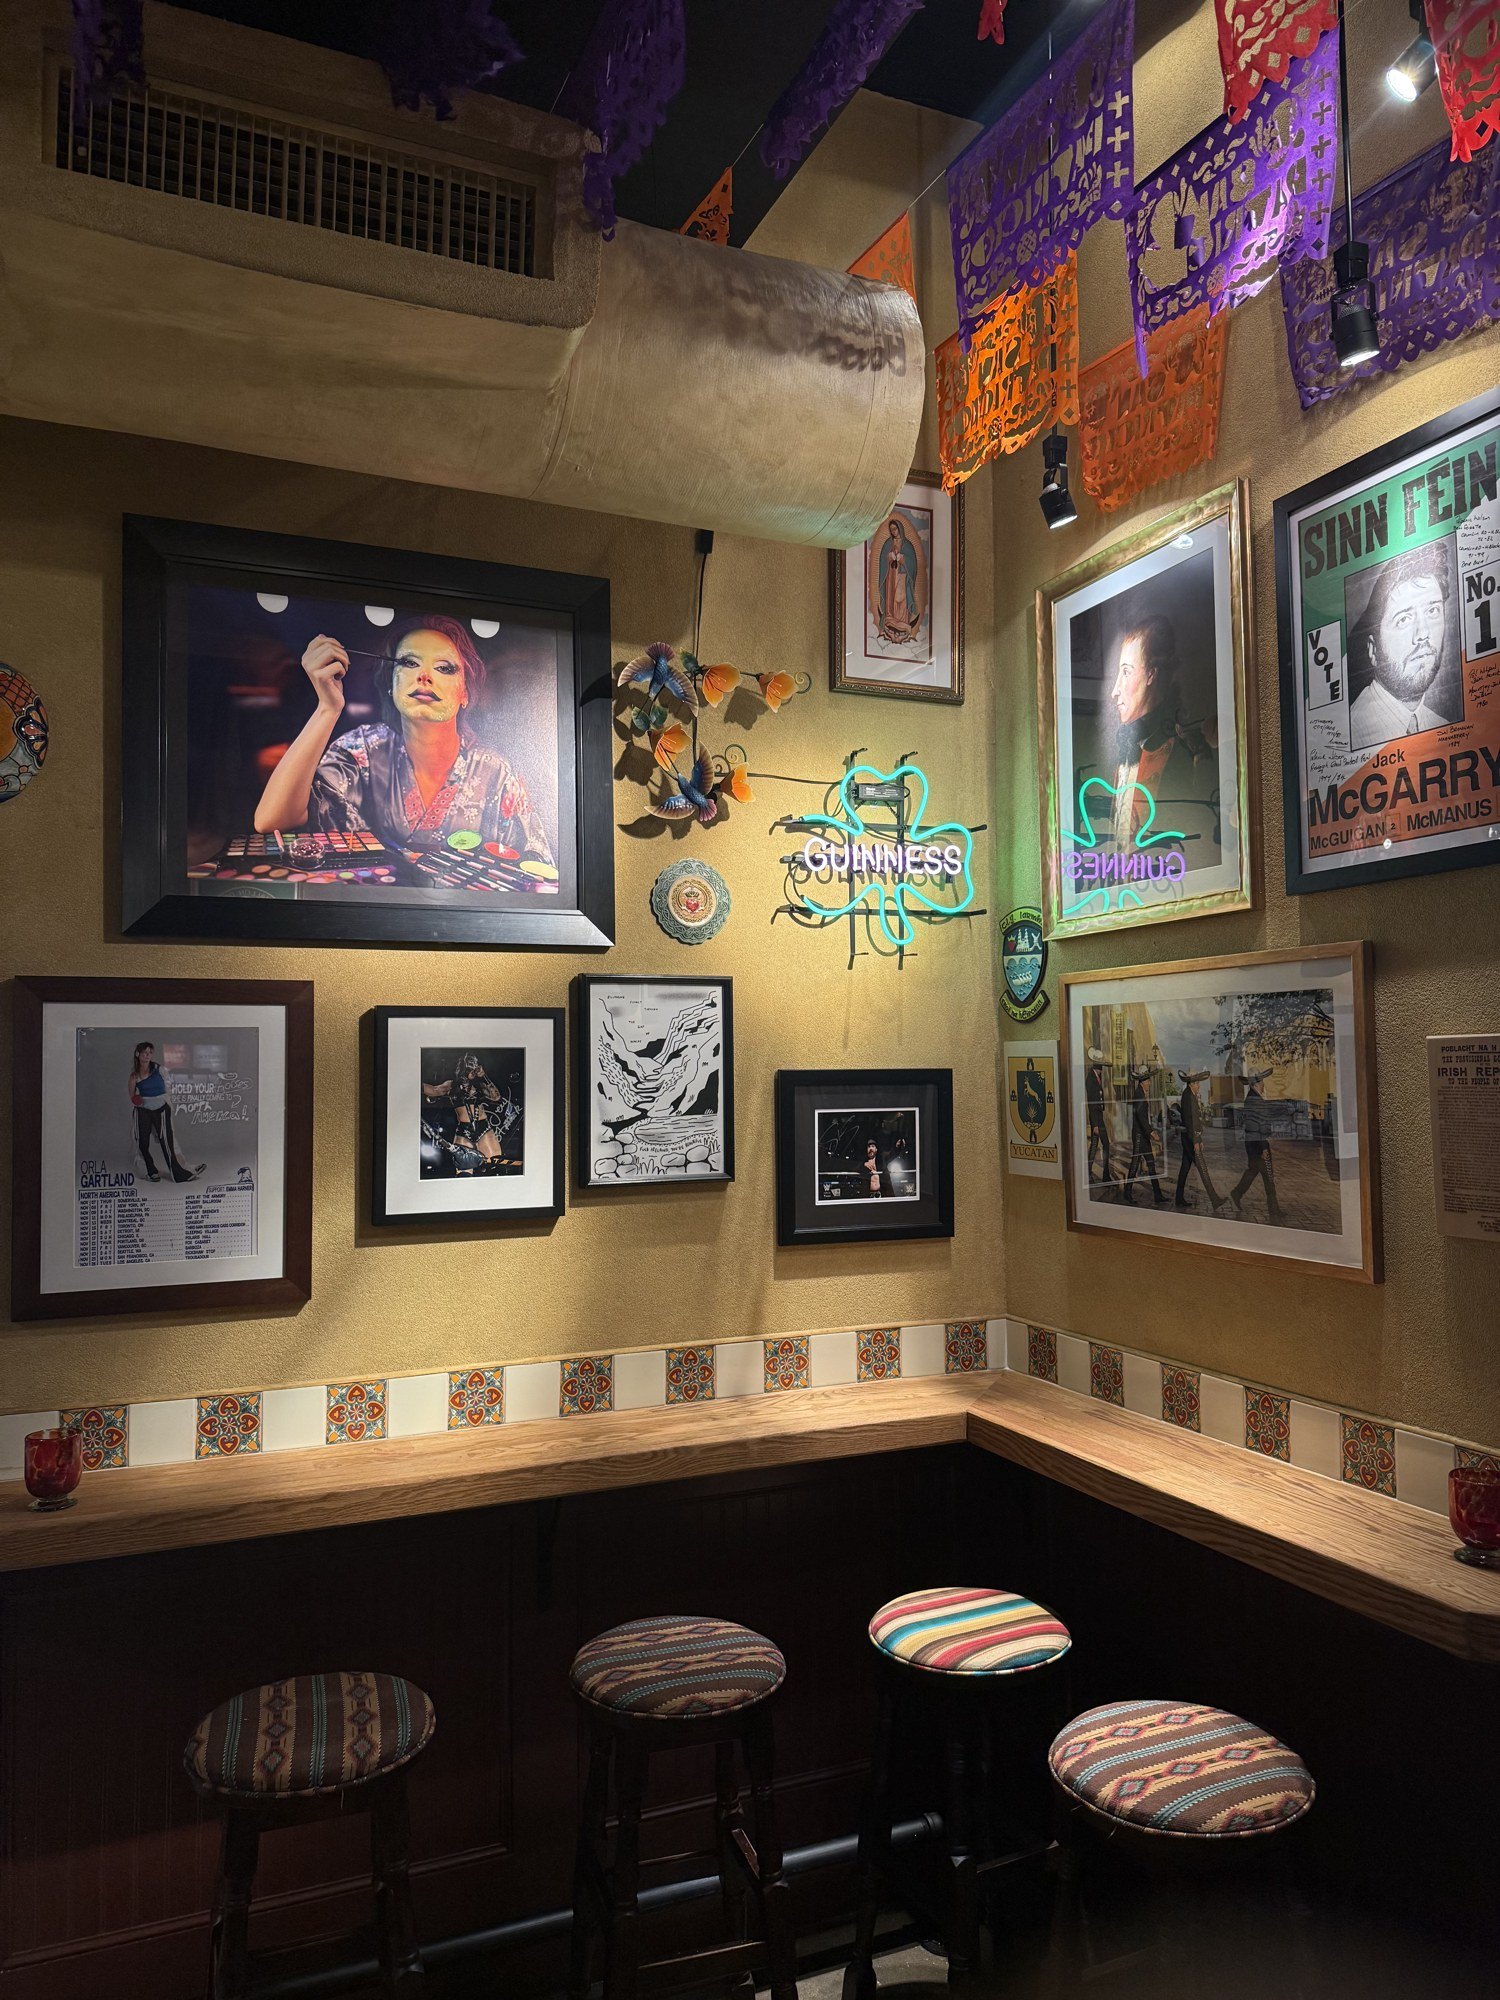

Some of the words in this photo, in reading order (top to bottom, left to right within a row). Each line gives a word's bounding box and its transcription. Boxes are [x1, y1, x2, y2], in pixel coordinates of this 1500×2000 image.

[1304, 493, 1389, 580] SINN
[1402, 440, 1498, 538] FÉIN
[1475, 600, 1497, 655] 1
[1308, 629, 1341, 703] VOTE
[1372, 748, 1406, 769] Jack
[1310, 744, 1500, 827] McGARRY
[1310, 822, 1387, 852] McGUIGAN
[1389, 822, 1397, 831] 2
[1407, 798, 1492, 832] McMANUS
[804, 836, 963, 876] GUINNESS
[1437, 1066, 1468, 1077] IRISH
[171, 1083, 192, 1095] HOLD
[194, 1082, 215, 1094] YOUR
[1012, 1145, 1055, 1159] YUCATAN
[80, 1160, 107, 1175] ORLA
[80, 1173, 135, 1188] GARTLAND
[80, 1191, 98, 1200] NORTH
[99, 1190, 121, 1198] AMERICA
